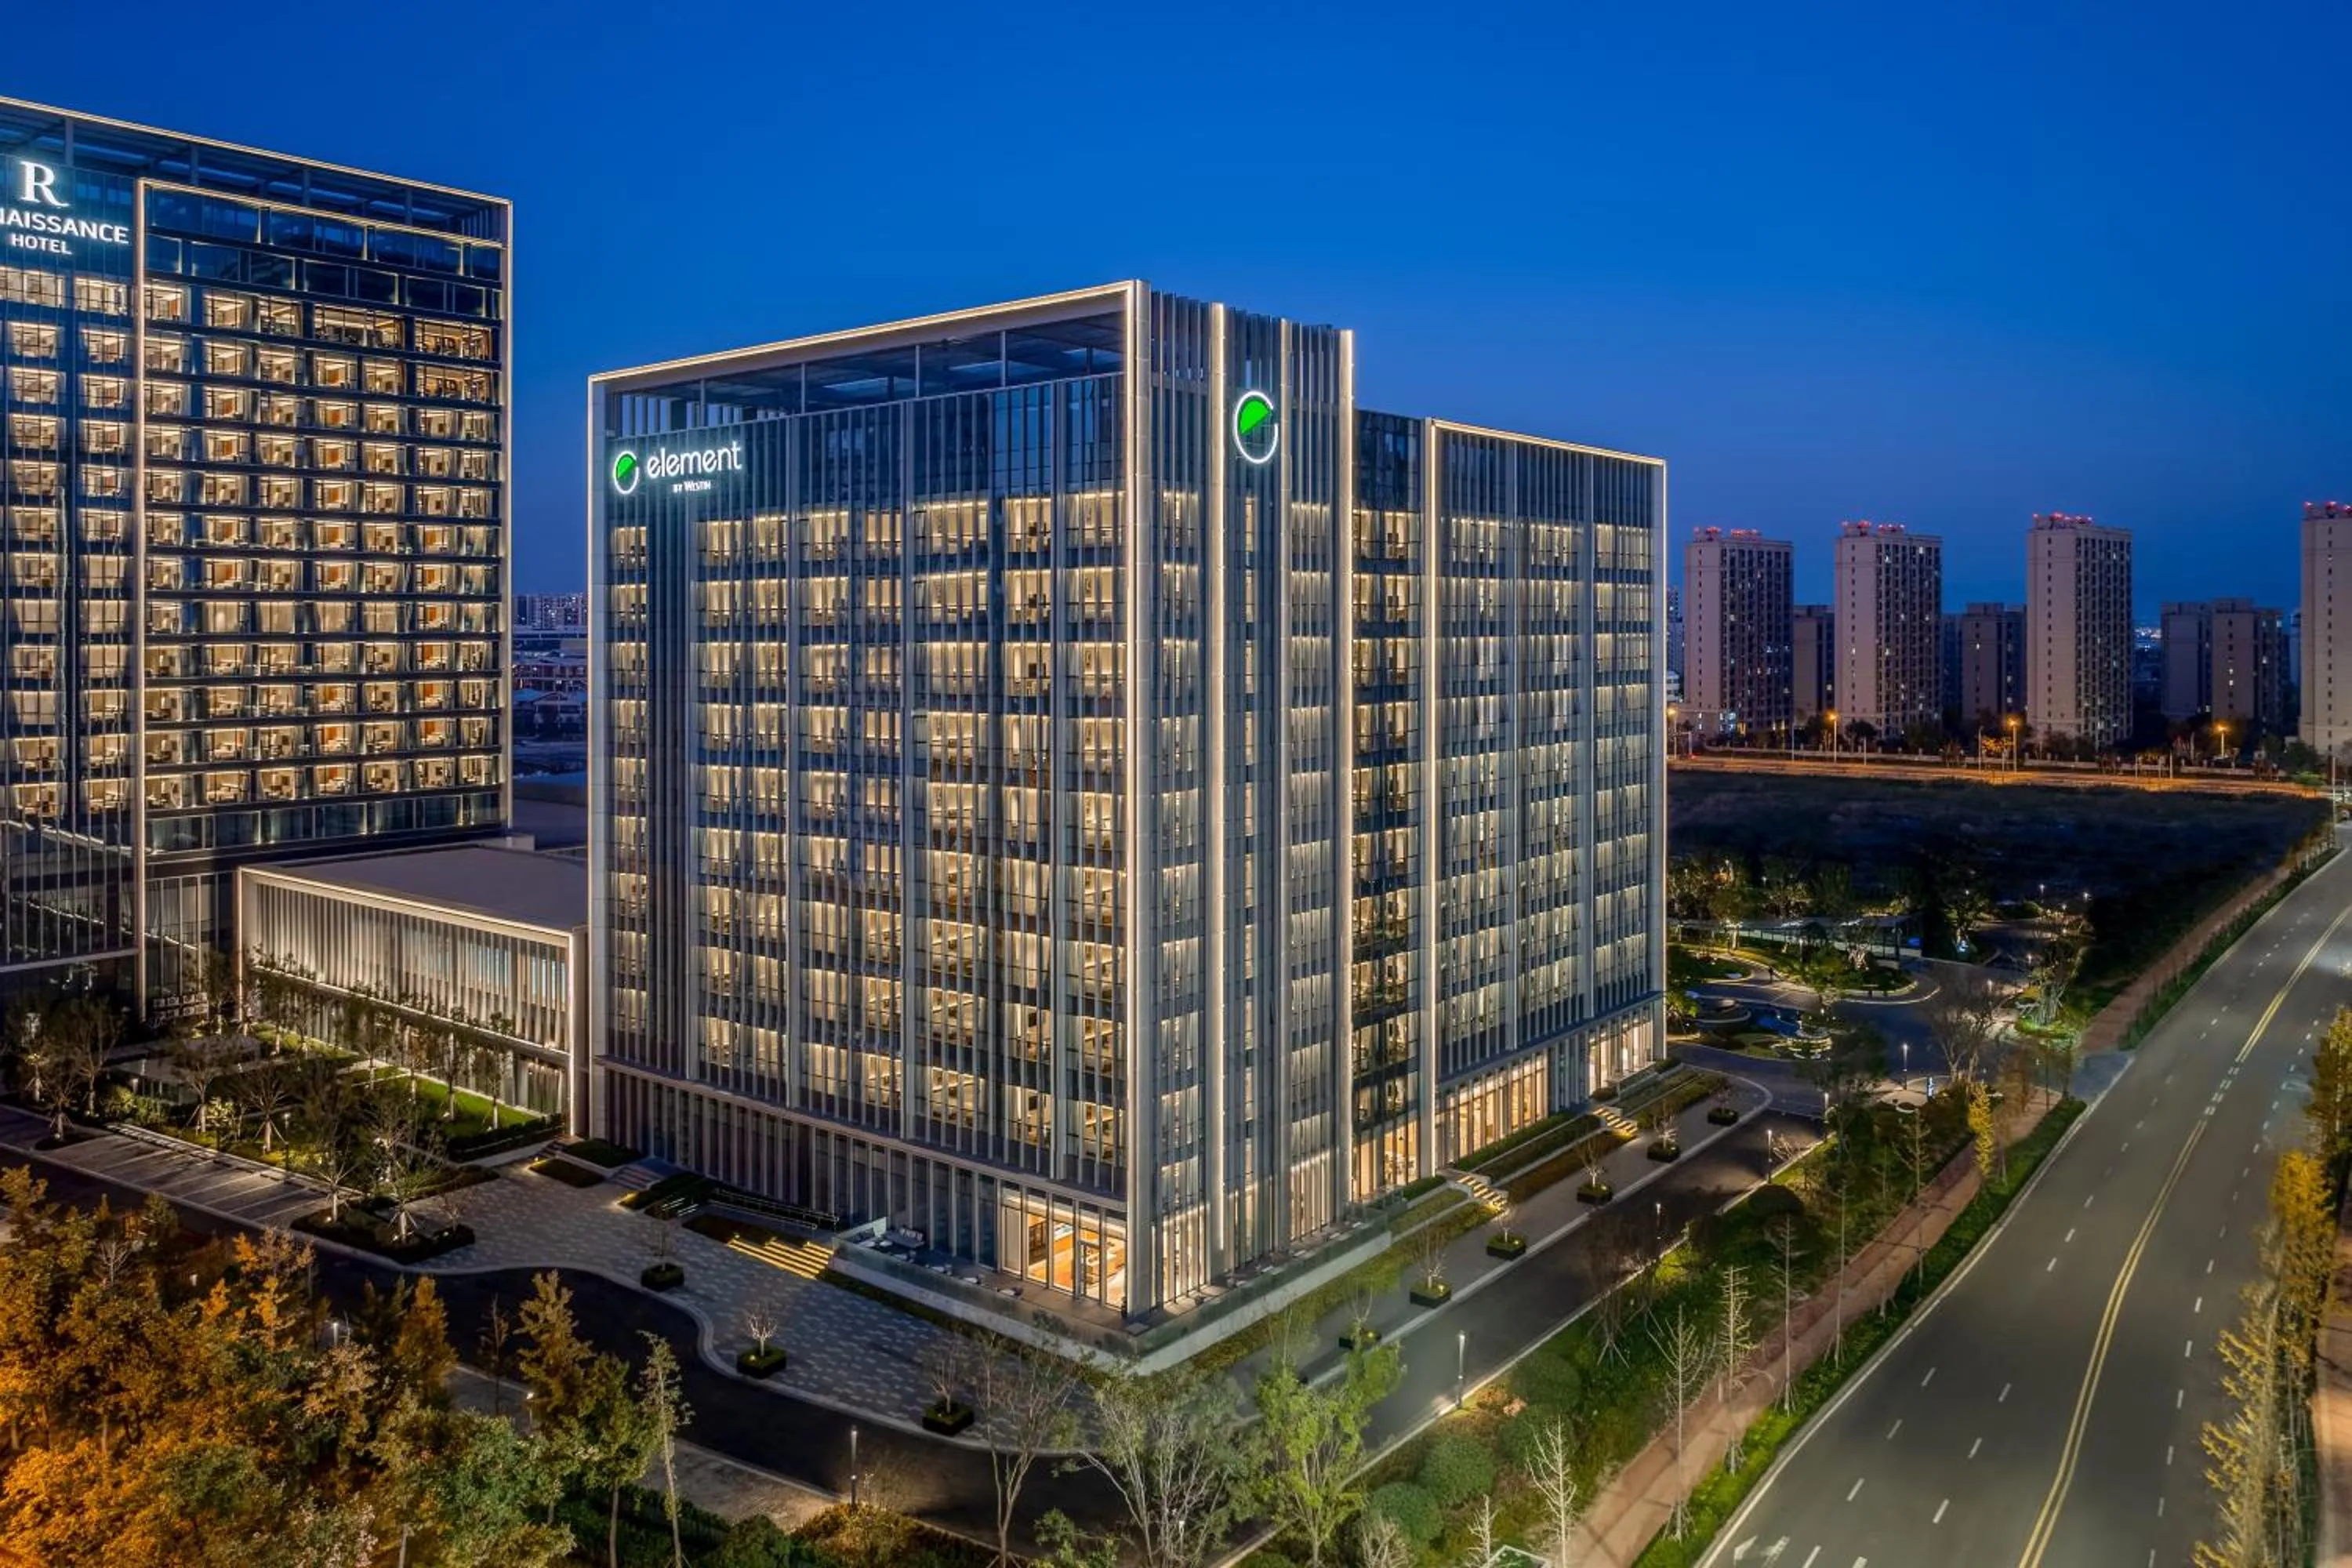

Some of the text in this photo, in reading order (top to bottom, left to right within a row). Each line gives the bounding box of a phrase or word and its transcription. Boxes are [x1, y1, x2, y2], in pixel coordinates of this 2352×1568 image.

[20, 160, 70, 208] R
[11, 233, 72, 255] HOTEL
[647, 441, 742, 478] element
